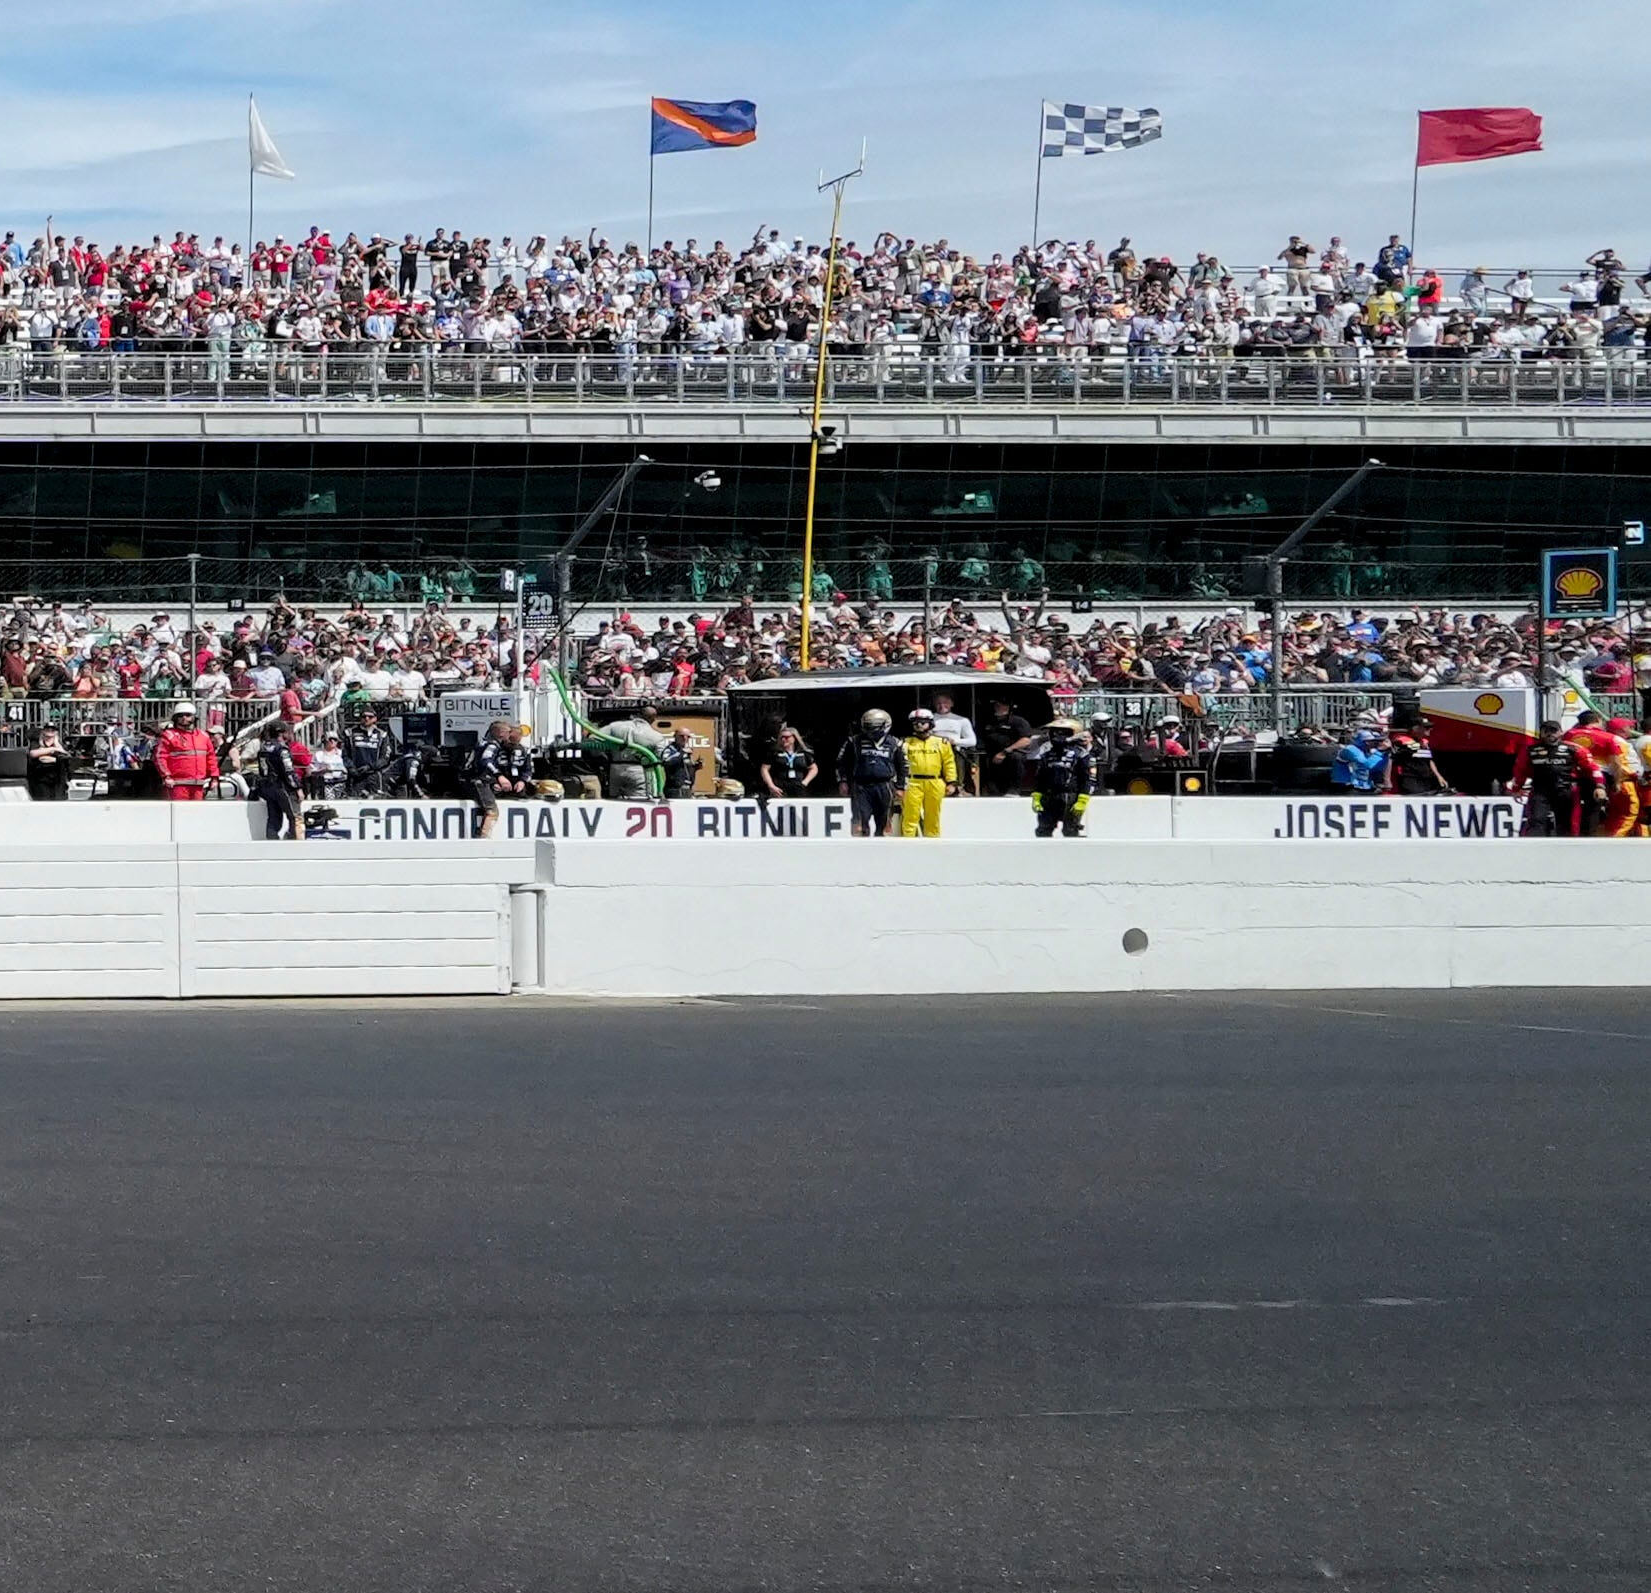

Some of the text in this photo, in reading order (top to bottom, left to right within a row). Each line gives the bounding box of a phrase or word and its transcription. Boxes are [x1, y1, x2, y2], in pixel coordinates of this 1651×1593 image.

[528, 594, 554, 616] 20
[446, 698, 511, 711] BITNILE
[626, 806, 673, 839] 20
[1274, 804, 1392, 839] JOSEF
